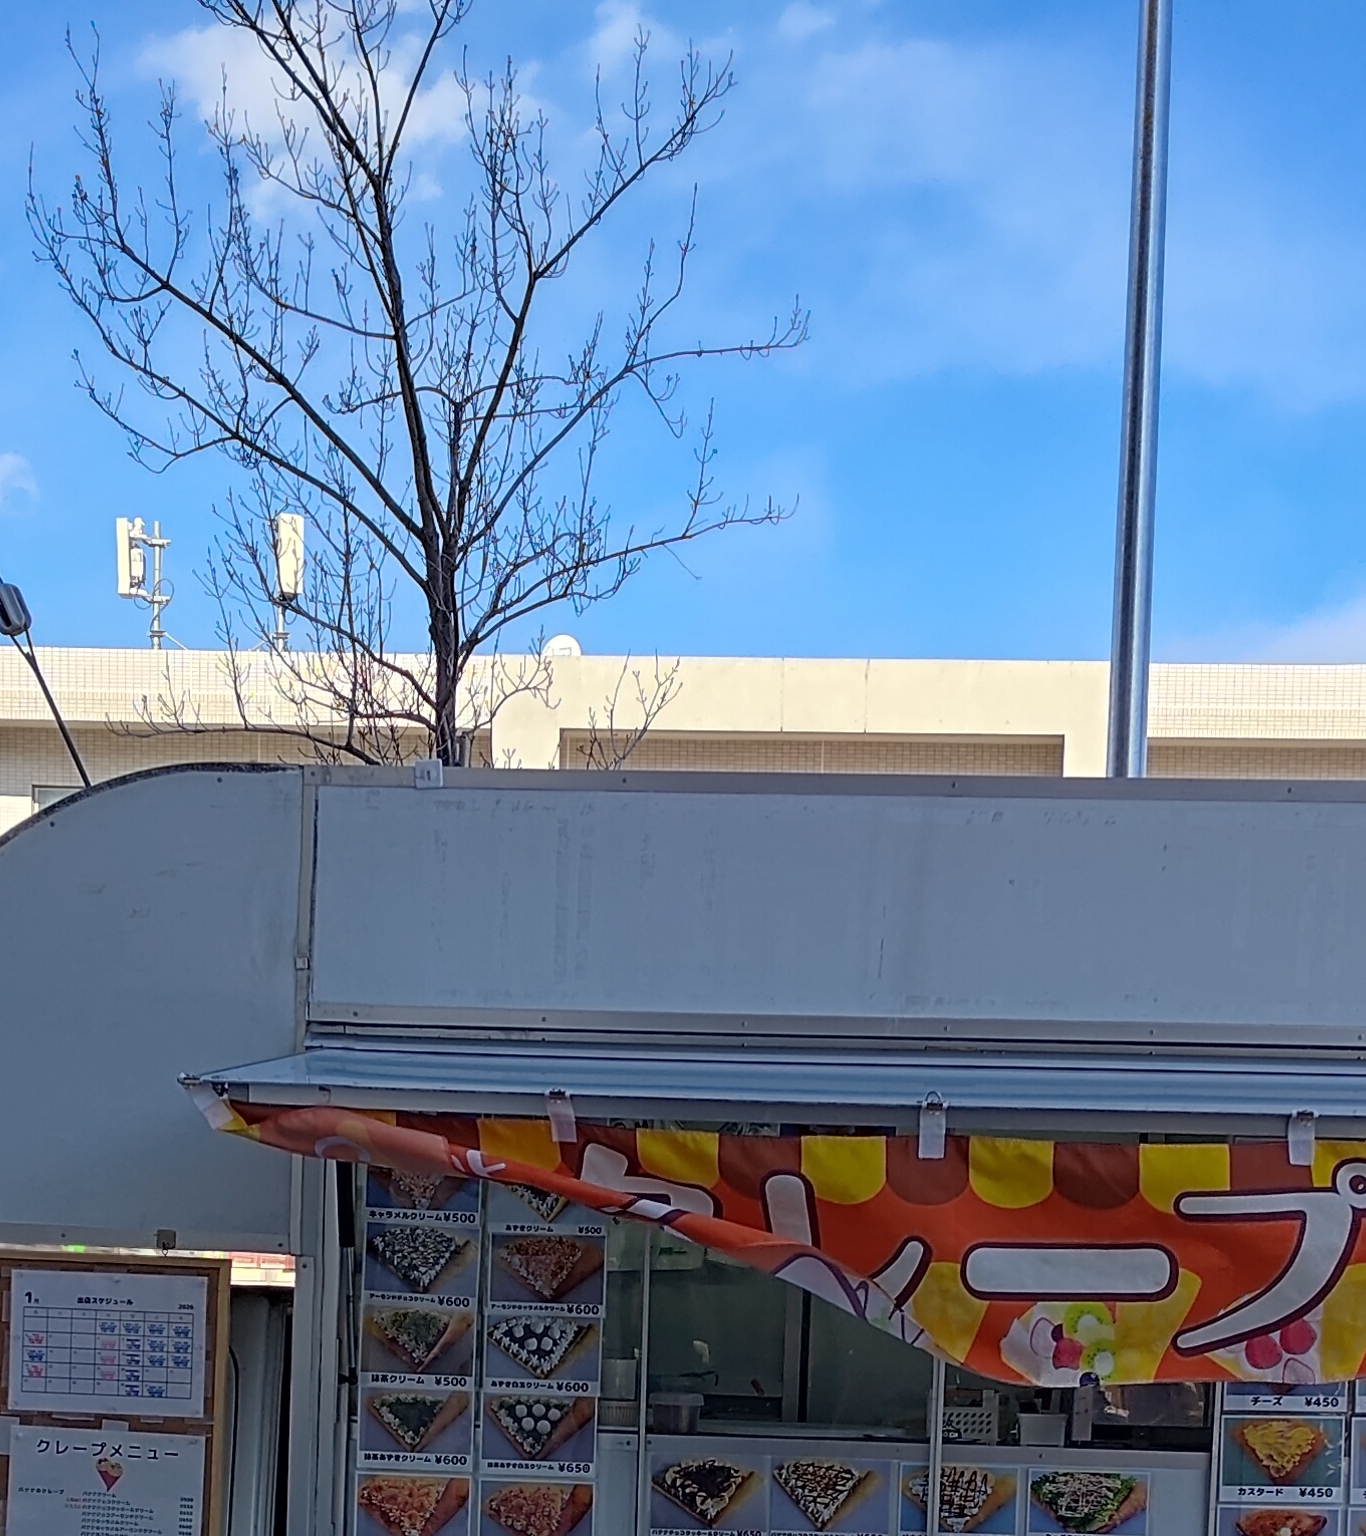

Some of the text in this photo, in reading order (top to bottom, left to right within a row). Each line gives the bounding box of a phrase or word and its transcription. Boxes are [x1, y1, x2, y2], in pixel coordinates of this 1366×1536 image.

[369, 1209, 476, 1224] キャラメルクリーム ¥500
[578, 1226, 602, 1234] ¥500
[437, 1296, 470, 1308] ¥600
[567, 1304, 600, 1315] ¥600
[435, 1376, 467, 1387] ¥500
[556, 1382, 589, 1393] ¥600
[1251, 1397, 1339, 1407] チーズ ¥450
[37, 1438, 179, 1461] クレープメニュー
[435, 1455, 467, 1466] ¥600
[558, 1462, 591, 1473] ¥650
[1238, 1487, 1333, 1498] カスタード ¥450
